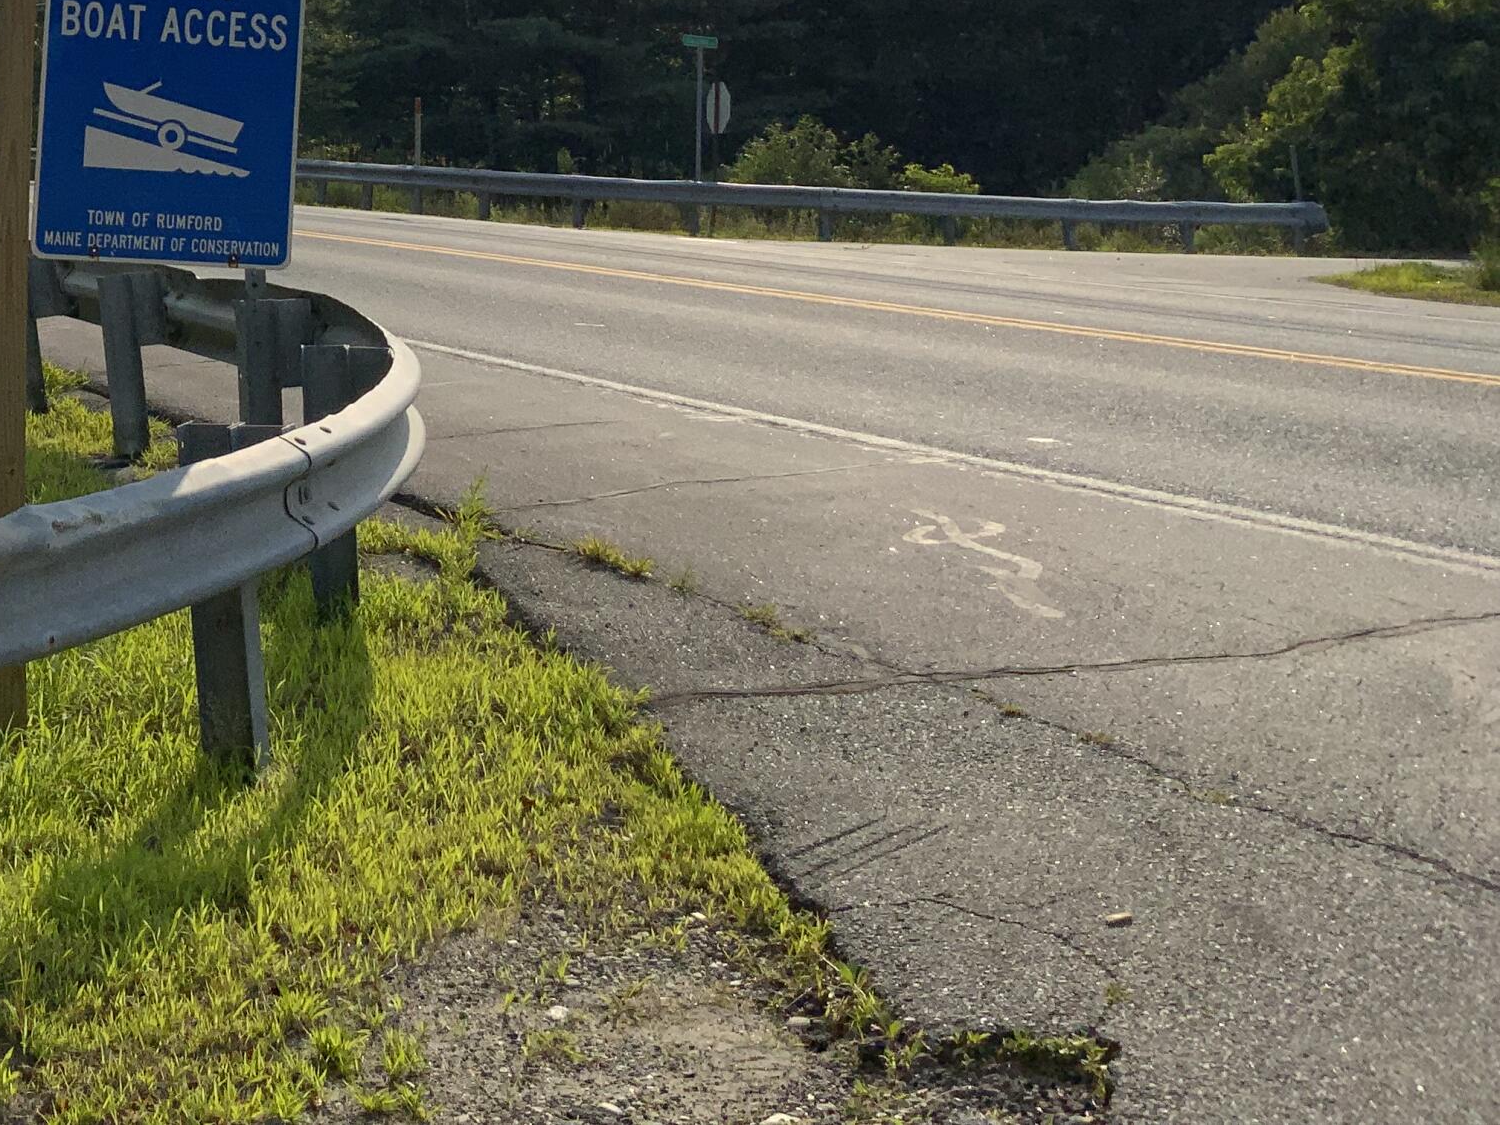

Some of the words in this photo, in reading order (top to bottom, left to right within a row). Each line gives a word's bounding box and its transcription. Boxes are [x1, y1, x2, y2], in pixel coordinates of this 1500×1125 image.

[61, 0, 146, 40] BOAT
[160, 7, 288, 51] ACCESS
[87, 210, 125, 226] TOWN
[132, 212, 150, 227] OF
[156, 214, 222, 232] RUMFORD
[44, 231, 82, 247] MAINE
[88, 233, 166, 252] DEPARTMENT
[171, 237, 185, 252] OF
[191, 238, 279, 257] CONSERVATION
